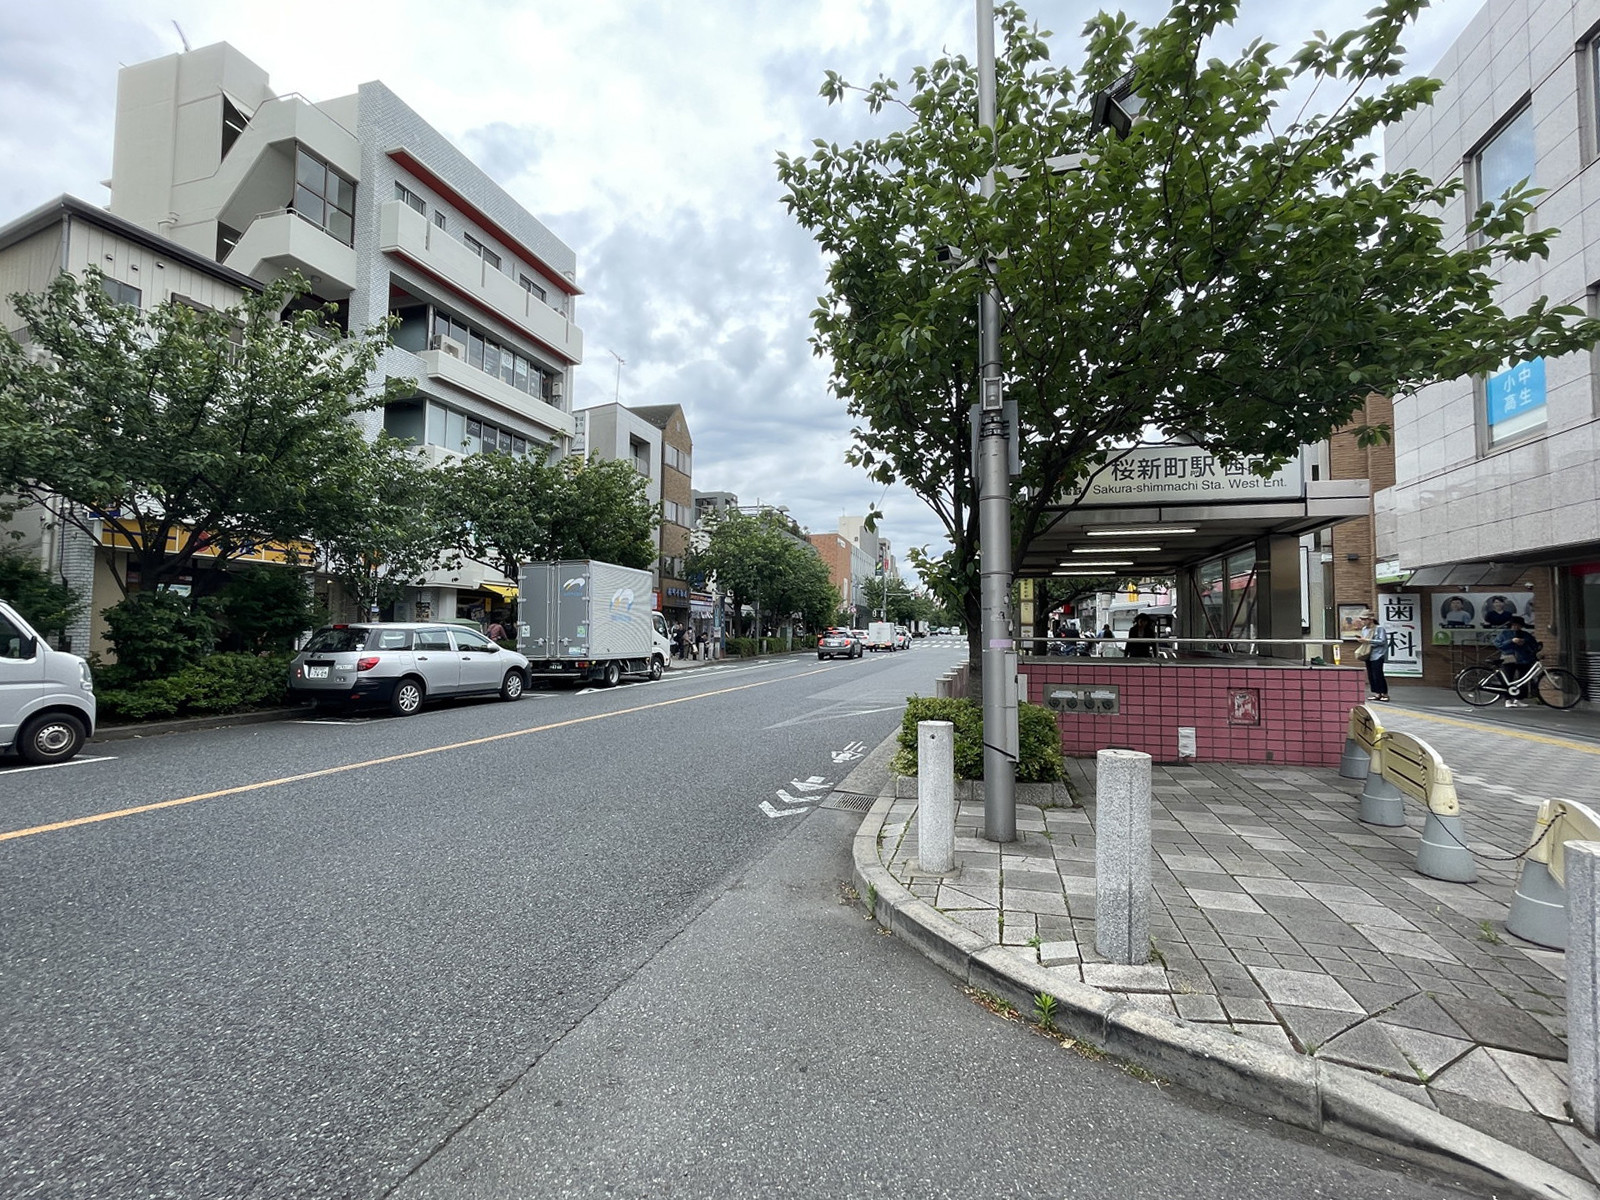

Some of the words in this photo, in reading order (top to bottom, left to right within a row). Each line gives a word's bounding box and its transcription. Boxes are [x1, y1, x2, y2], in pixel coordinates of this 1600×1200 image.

[1503, 368, 1531, 393] 小中
[1503, 387, 1532, 413] 高生
[1111, 455, 1216, 481] 桜新町駅
[1092, 480, 1199, 495] Sakura-shimmachi
[1201, 479, 1225, 491] Sta.
[1228, 478, 1260, 489] West
[1263, 477, 1287, 488] Ent.
[1384, 596, 1417, 657] 歯科
